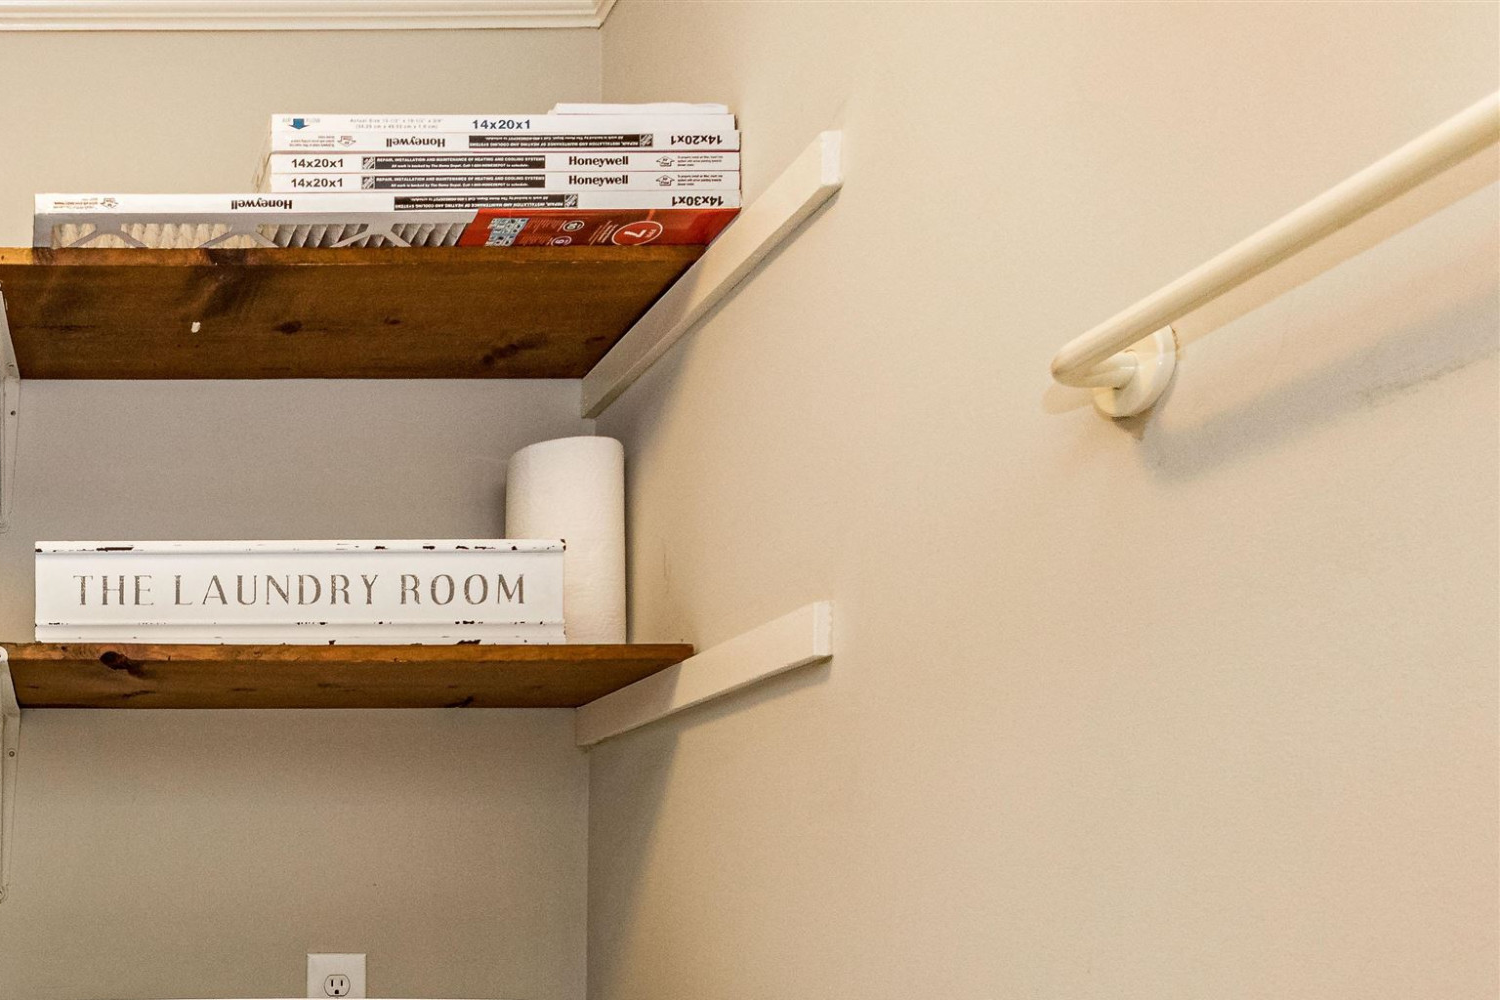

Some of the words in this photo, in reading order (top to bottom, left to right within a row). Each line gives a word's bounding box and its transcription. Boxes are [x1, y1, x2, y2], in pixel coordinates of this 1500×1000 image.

[472, 119, 530, 129] 14x20x1
[386, 138, 446, 148] Honeywell
[670, 135, 723, 145] 14x20x1
[291, 158, 344, 168] 14x20x1
[569, 156, 629, 167] Honeywell
[291, 178, 343, 188] 14x20x1
[569, 175, 629, 186] Honeywell
[231, 199, 293, 210] Honeywell
[671, 196, 724, 207] 14x30x1
[73, 574, 153, 606] THE
[173, 574, 379, 606] LAUNDRY
[400, 573, 526, 606] ROOM
